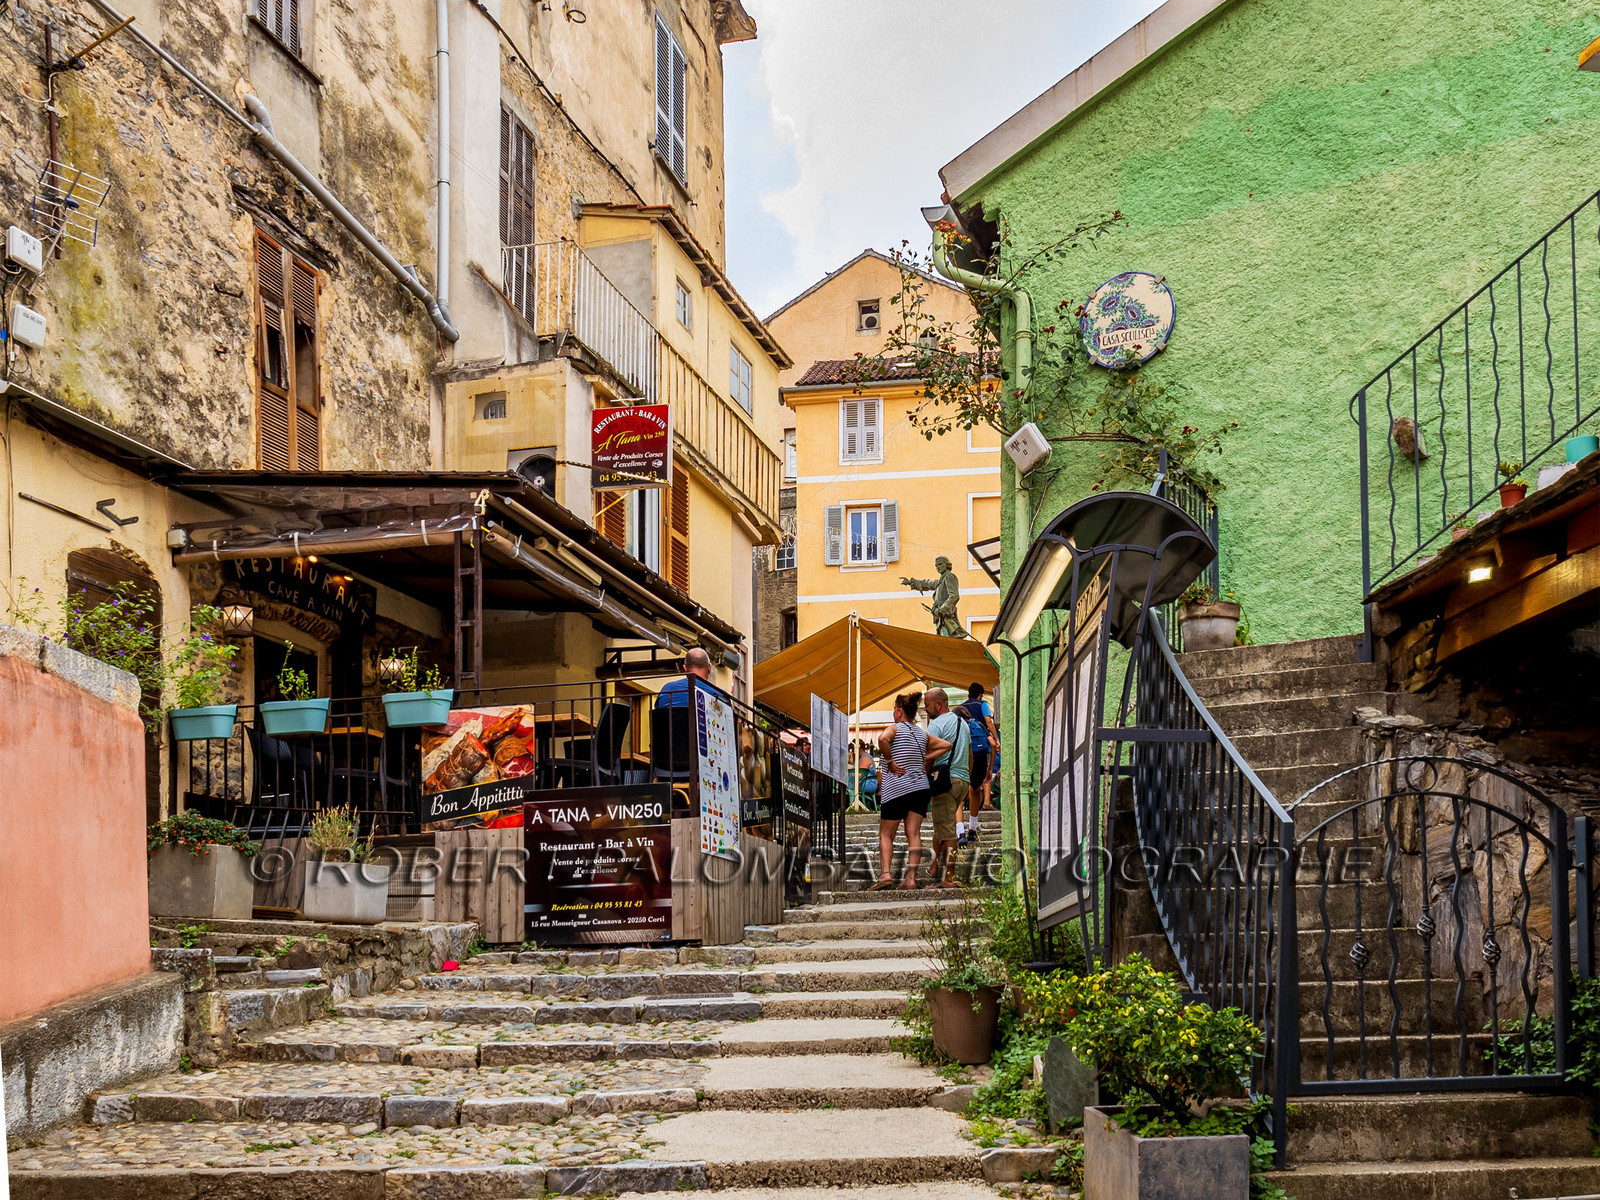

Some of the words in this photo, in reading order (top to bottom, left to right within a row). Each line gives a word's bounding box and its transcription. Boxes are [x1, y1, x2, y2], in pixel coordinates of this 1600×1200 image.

[1103, 334, 1120, 346] CASA
[594, 409, 634, 434] RESTAURANT
[639, 410, 652, 419] BAR
[656, 417, 667, 430] VIN
[594, 434, 613, 454] A
[613, 430, 641, 448] Tana
[654, 430, 665, 438] 250
[620, 452, 643, 460] Produits
[600, 474, 609, 482] 04
[612, 473, 621, 481] 95
[234, 557, 369, 625] RESTAURANT
[268, 581, 300, 603] CAVE
[308, 597, 315, 609] A
[431, 794, 458, 816] Bon
[462, 786, 524, 811] Appitittù
[532, 810, 543, 824] A
[548, 807, 590, 823] TANA
[607, 803, 662, 820] VIN250
[540, 842, 595, 852] Restaurant
[605, 839, 624, 848] Bar
[627, 839, 633, 847] à
[636, 837, 654, 846] Vin
[575, 866, 617, 874] d'excellence
[604, 901, 613, 909] 95
[624, 900, 632, 908] 81
[552, 919, 591, 928] Monseigneur
